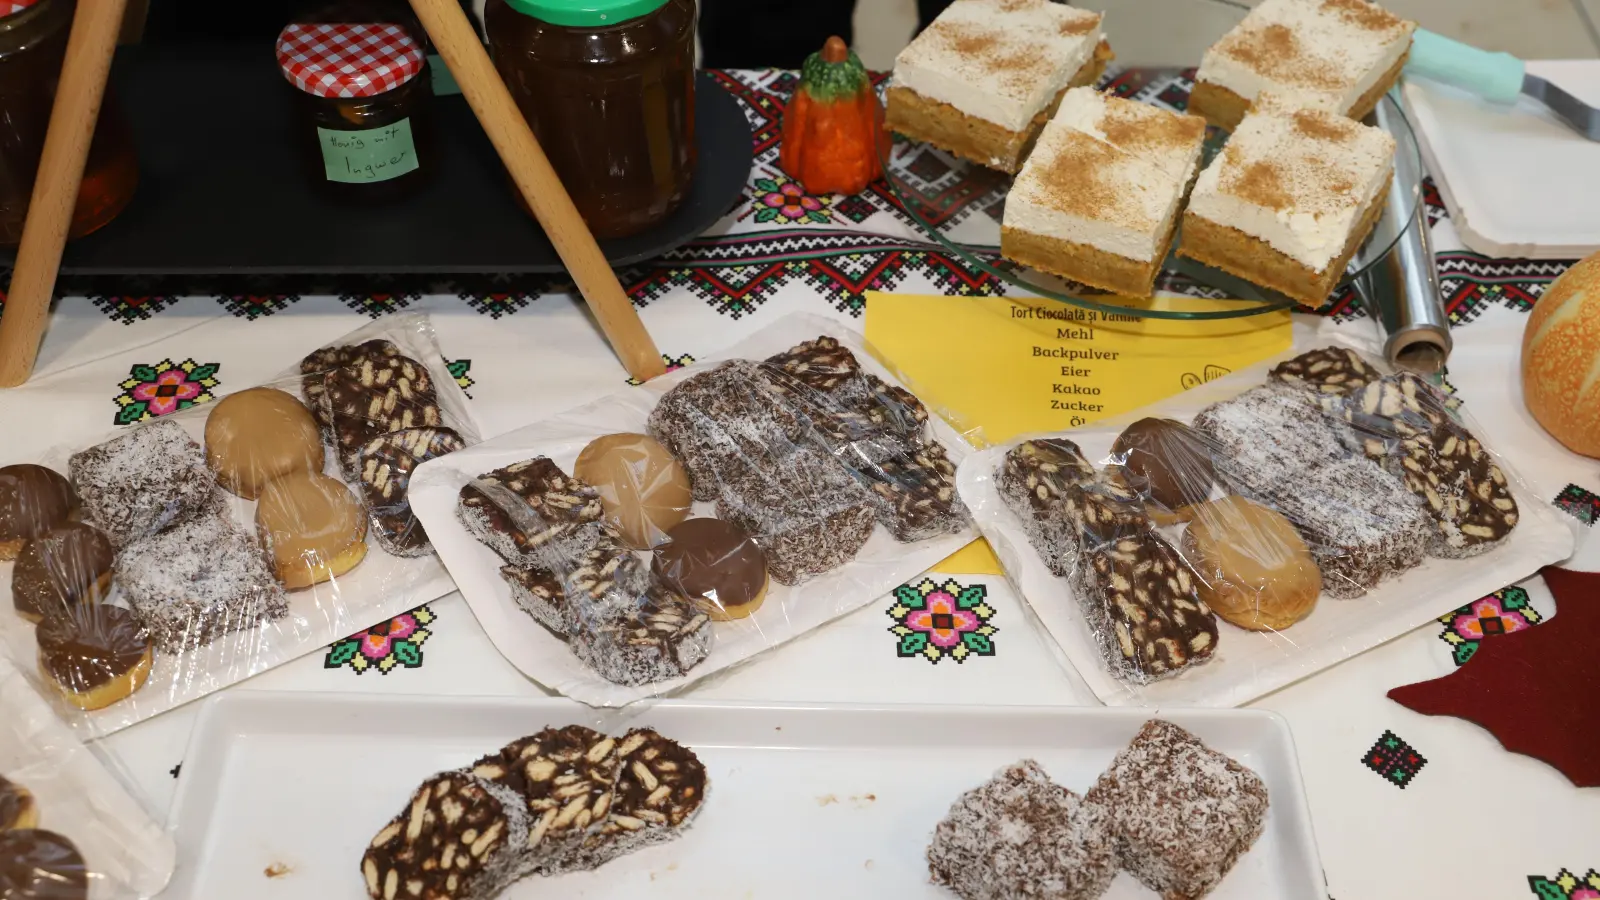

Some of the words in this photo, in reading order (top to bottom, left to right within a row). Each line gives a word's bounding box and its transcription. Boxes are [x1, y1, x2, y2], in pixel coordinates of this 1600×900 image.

[330, 136, 364, 149] Honig
[374, 126, 399, 142] mit
[345, 151, 407, 178] Ingwer
[1011, 306, 1033, 318] Tort
[1036, 307, 1086, 321] Ciocolată
[1056, 328, 1094, 340] Mehl
[1032, 346, 1119, 361] Backpulver
[1061, 366, 1091, 377] Eier
[1052, 383, 1101, 395] Kakao
[1050, 400, 1104, 412] Zucker
